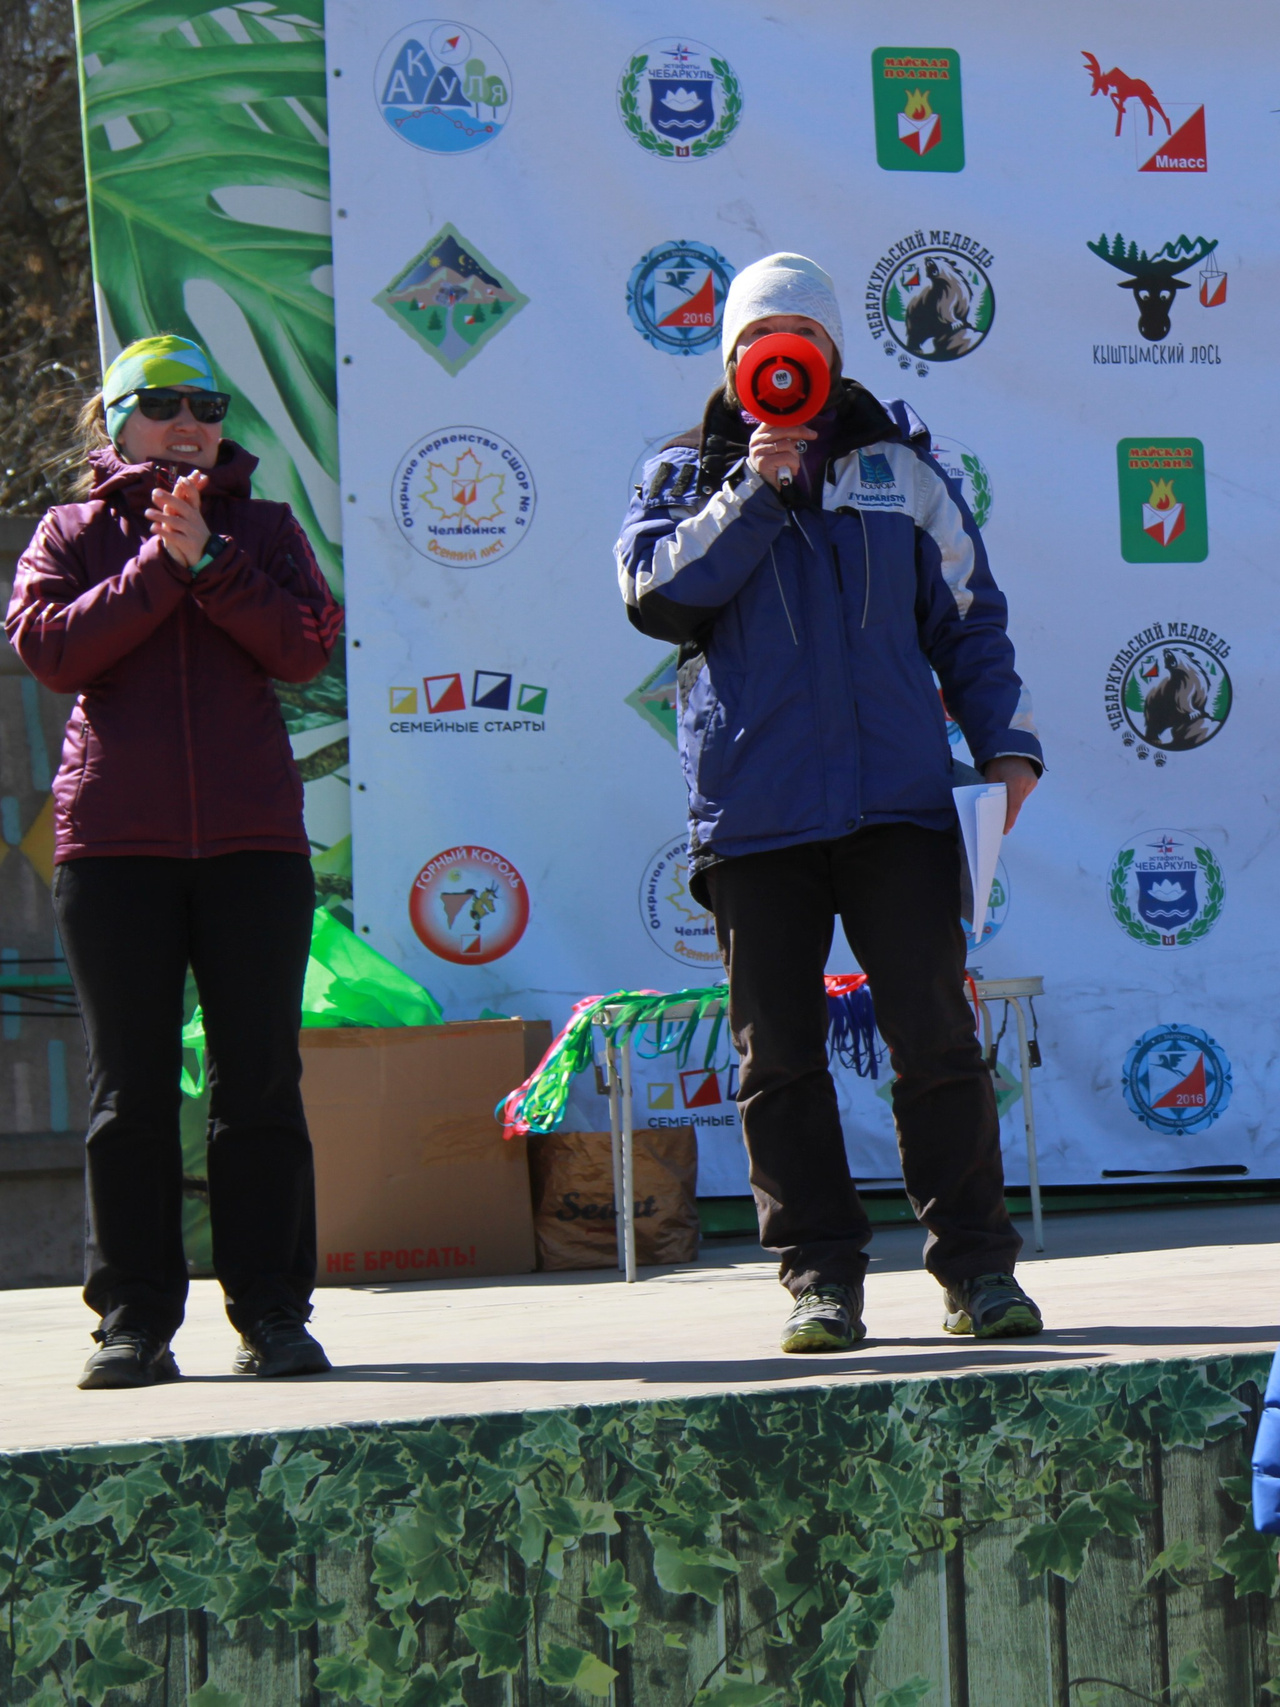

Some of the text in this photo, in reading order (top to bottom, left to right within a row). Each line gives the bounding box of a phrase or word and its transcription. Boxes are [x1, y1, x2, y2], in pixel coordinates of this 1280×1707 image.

[884, 56, 949, 68] МАЙСКАЯ
[648, 69, 715, 79] ЧЕБАРКУЛЬ
[884, 69, 949, 79] ПОЛЯНА
[1155, 155, 1205, 169] Миасс
[865, 229, 995, 340] ЧЕБАРКУЛЬСКИЙ МЕДВЕДЬ
[683, 312, 712, 324] 2016
[1128, 446, 1194, 458] МАЙСКАЯ
[1128, 459, 1194, 469] ПОЛЯНА
[400, 459, 418, 528] Открытое
[418, 434, 499, 458] первенство
[501, 450, 529, 490] СШОР
[428, 525, 507, 535] Челябинск
[1104, 621, 1231, 731] ЧЕБАРКУЛЬСКИЙ МЕДВЕДЬ
[389, 719, 545, 733] СЕМЕЙНЫЕ СТАРТЫ
[416, 847, 521, 890] ГОРНЫЙ КОРОЛЬ
[1135, 861, 1198, 871] ЧЕБАРКУЛЬ
[647, 861, 666, 930] Открытое
[1176, 1094, 1204, 1104] 2016
[647, 1114, 735, 1128] СЕМЕЙНЫЕ
[326, 1245, 477, 1273] НЕ БРОСАТЬ!
